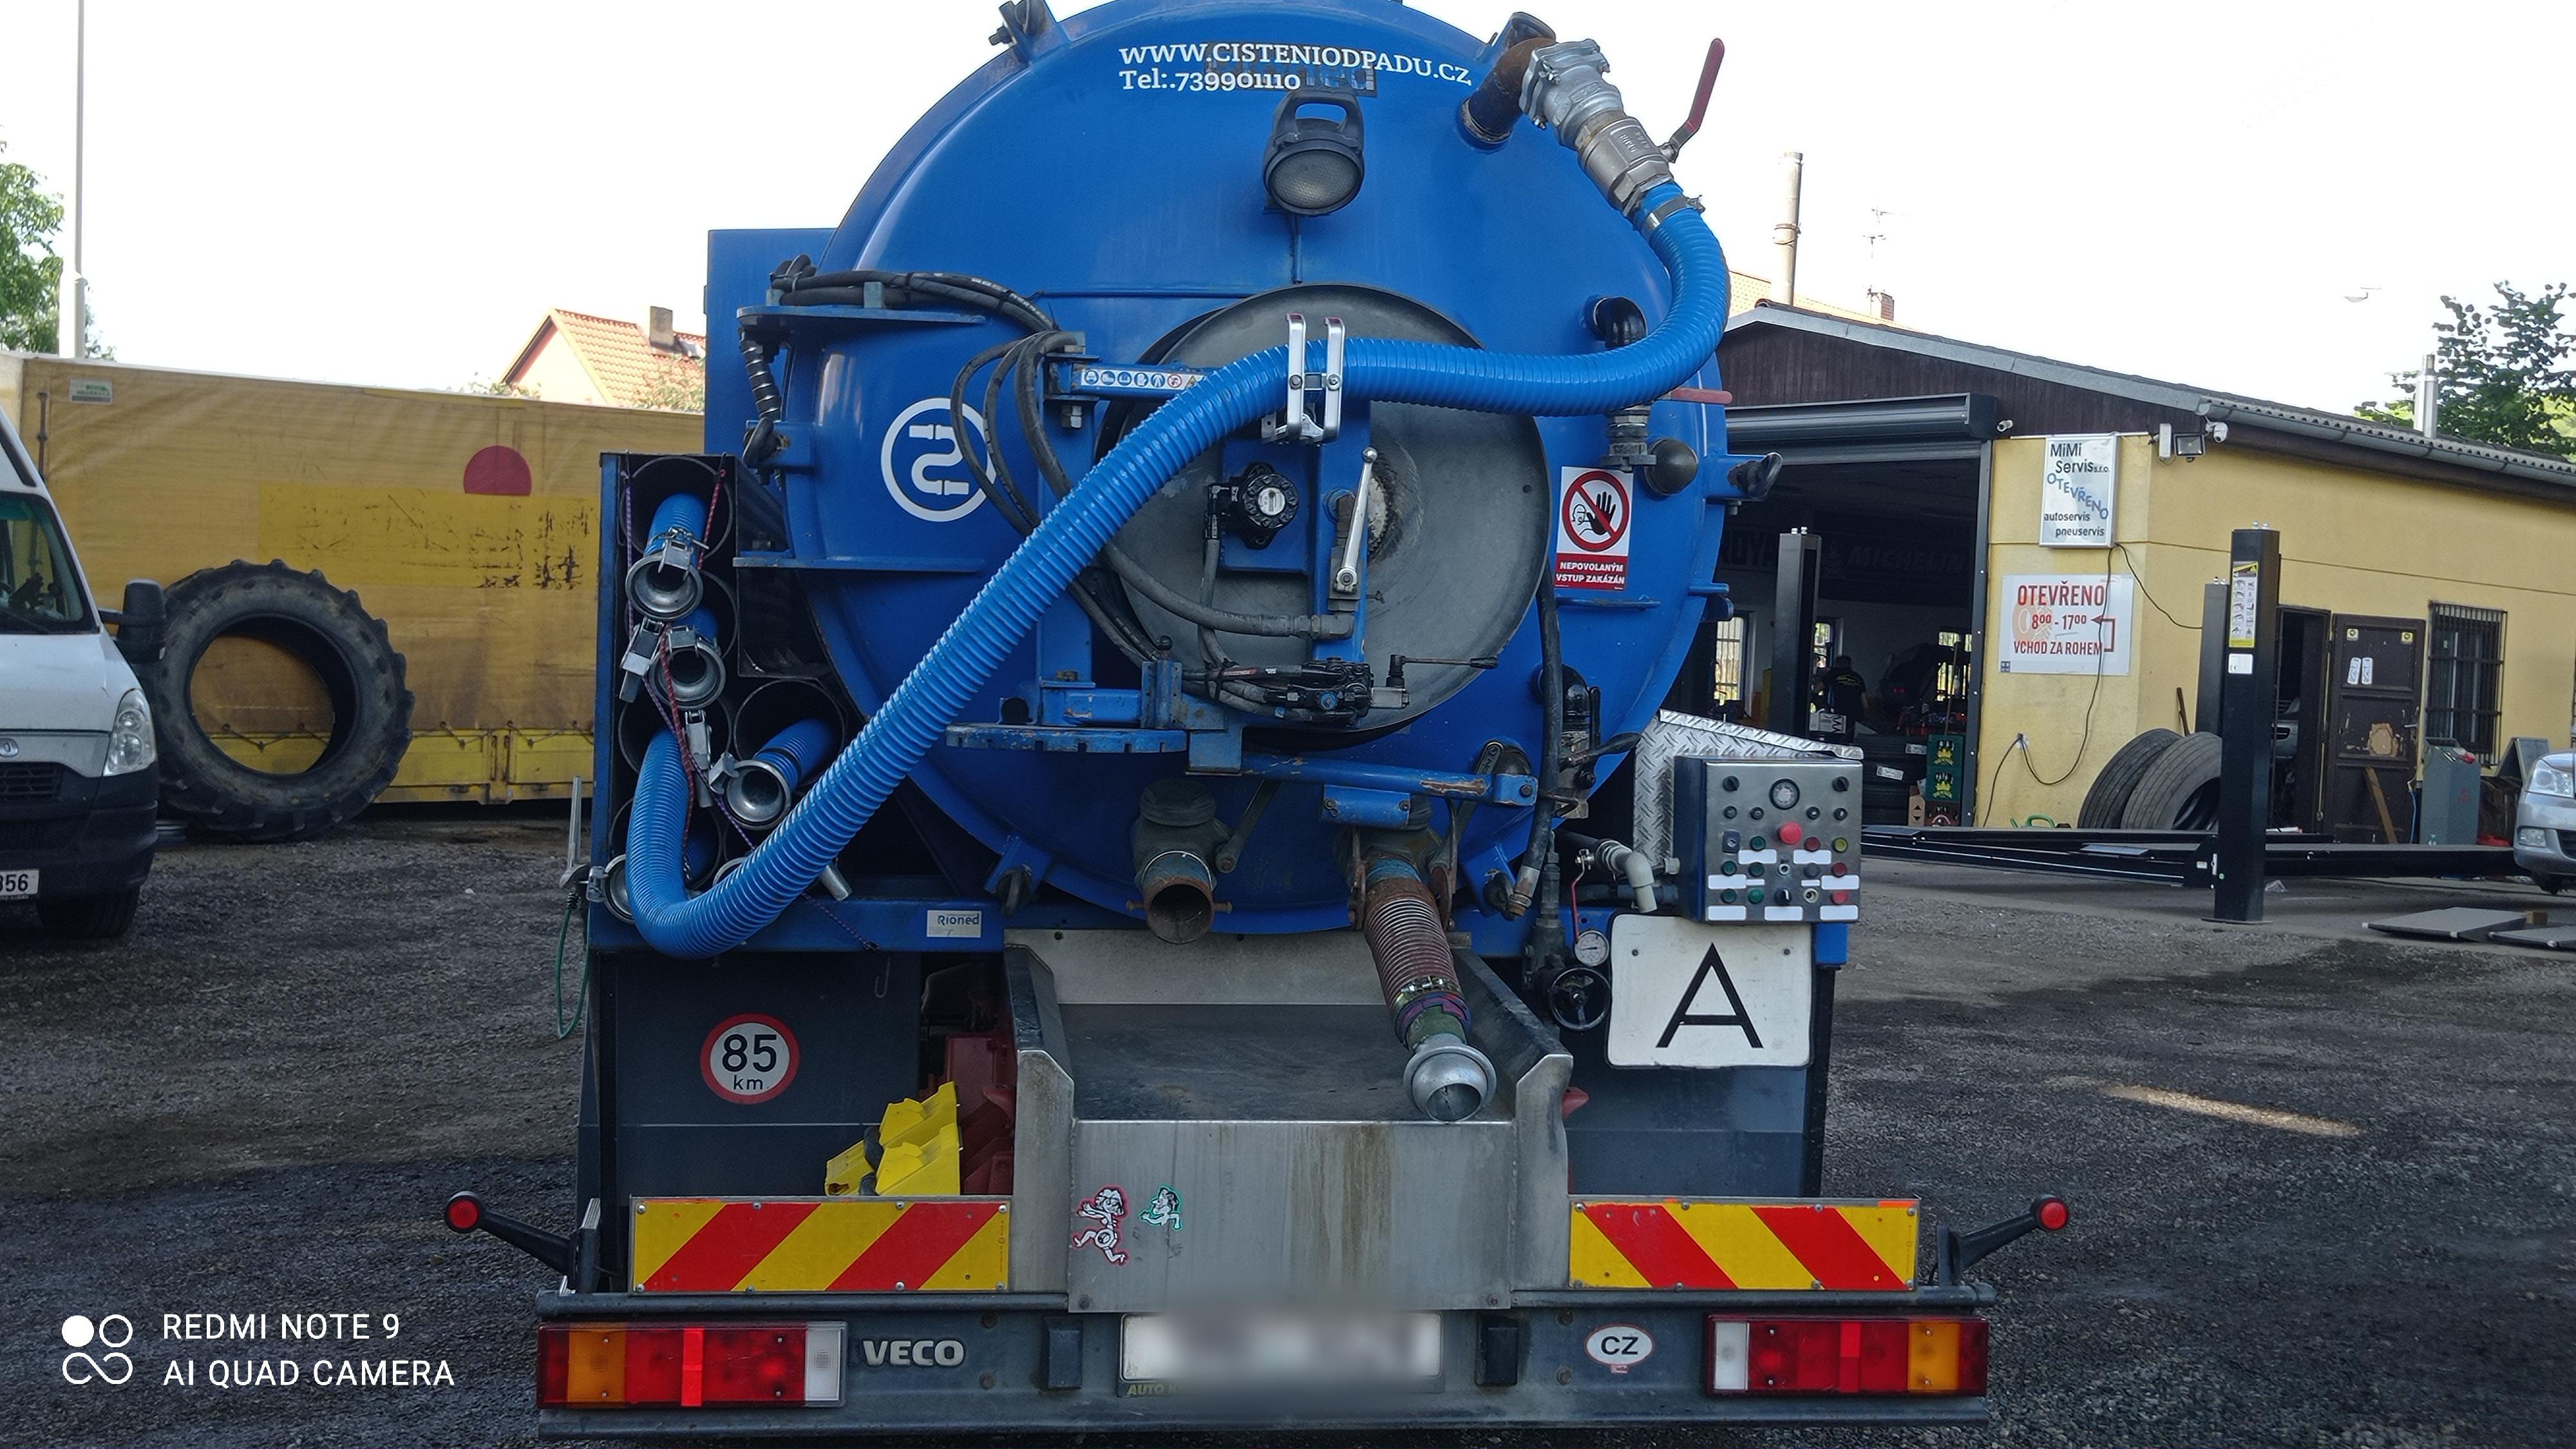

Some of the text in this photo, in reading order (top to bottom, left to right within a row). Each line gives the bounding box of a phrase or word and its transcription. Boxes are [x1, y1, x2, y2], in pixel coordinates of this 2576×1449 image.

[1119, 42, 1472, 86] WWW.CISTENIODPADU.CZ
[2050, 443, 2082, 457] MiMi
[2043, 511, 2091, 521] autoservis
[2055, 526, 2105, 538] pneuservis
[1560, 560, 1624, 573] NEPOVOLANÝM
[1555, 573, 1625, 584] VSTUP ZAKÁZÁN
[2018, 580, 2104, 606] OTEVŘENO
[2014, 641, 2102, 655] VCHOD ZA ROHEM
[937, 913, 980, 925] Rioned
[1656, 942, 1763, 1048] A
[722, 1034, 777, 1072] 85
[734, 1075, 763, 1090] km
[1601, 1336, 1638, 1355] CZ
[1126, 1383, 1164, 1396] AUTO
